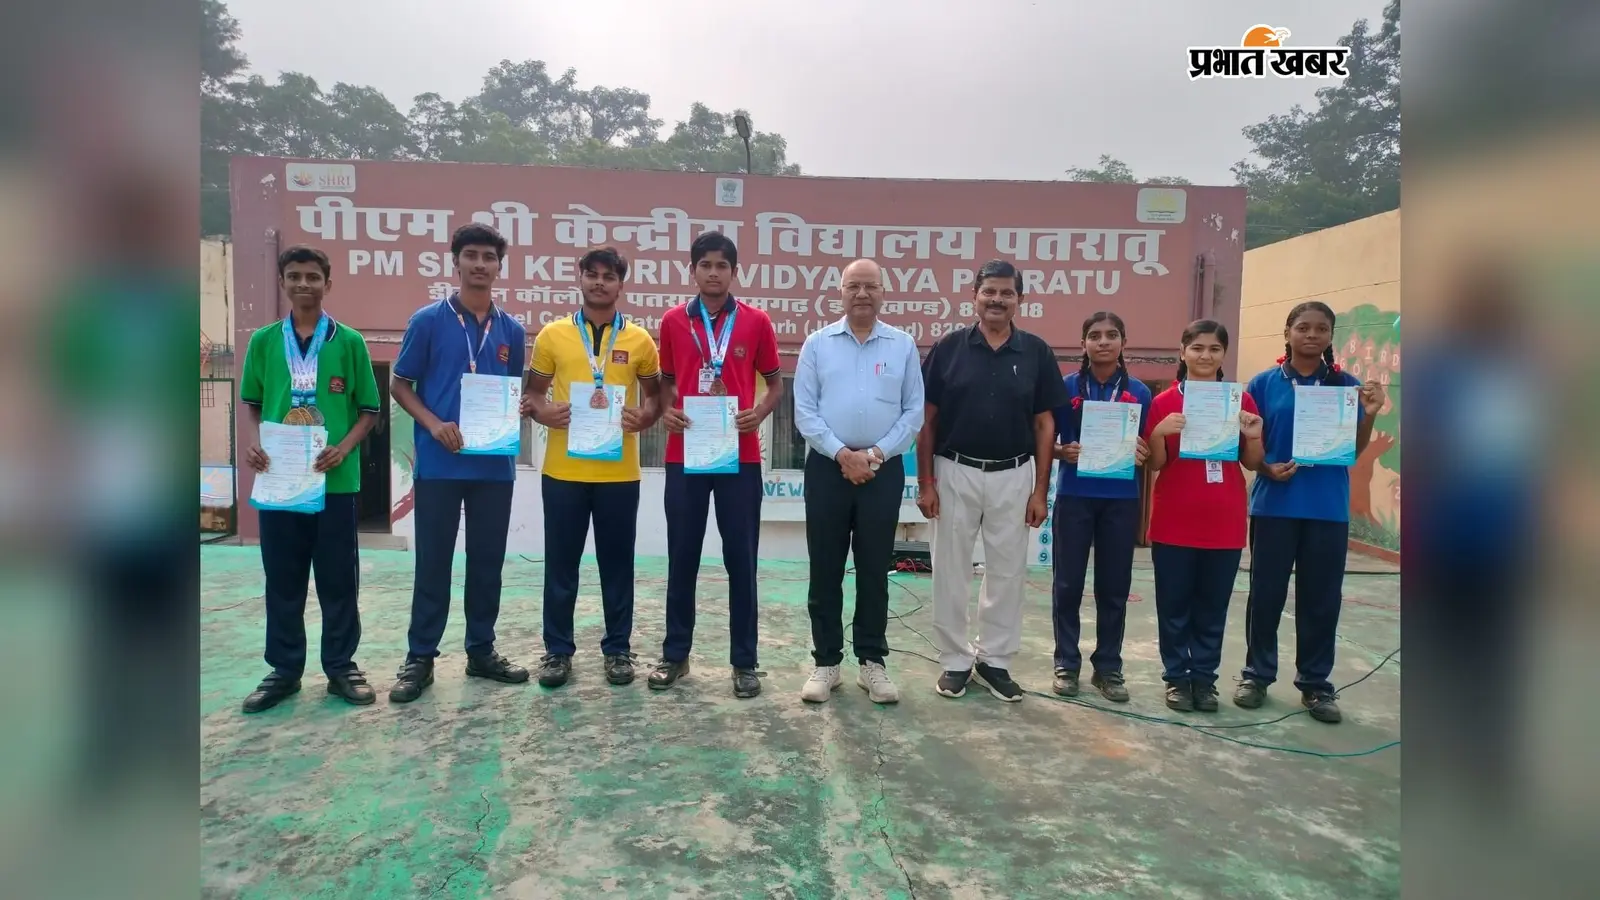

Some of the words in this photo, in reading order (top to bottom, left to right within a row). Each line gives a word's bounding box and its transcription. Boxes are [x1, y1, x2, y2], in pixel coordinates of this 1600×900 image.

[319, 175, 351, 186] SHRI
[296, 196, 455, 242] पीएम
[755, 212, 982, 260] विद्यालय
[993, 227, 1169, 277] पतरातू
[349, 250, 404, 276] PM
[524, 255, 698, 286] KERIY
[736, 263, 940, 293] VIDYAAYA
[953, 268, 1121, 295] PRATU
[1041, 533, 1049, 544] 8
[1039, 552, 1048, 562] 9
